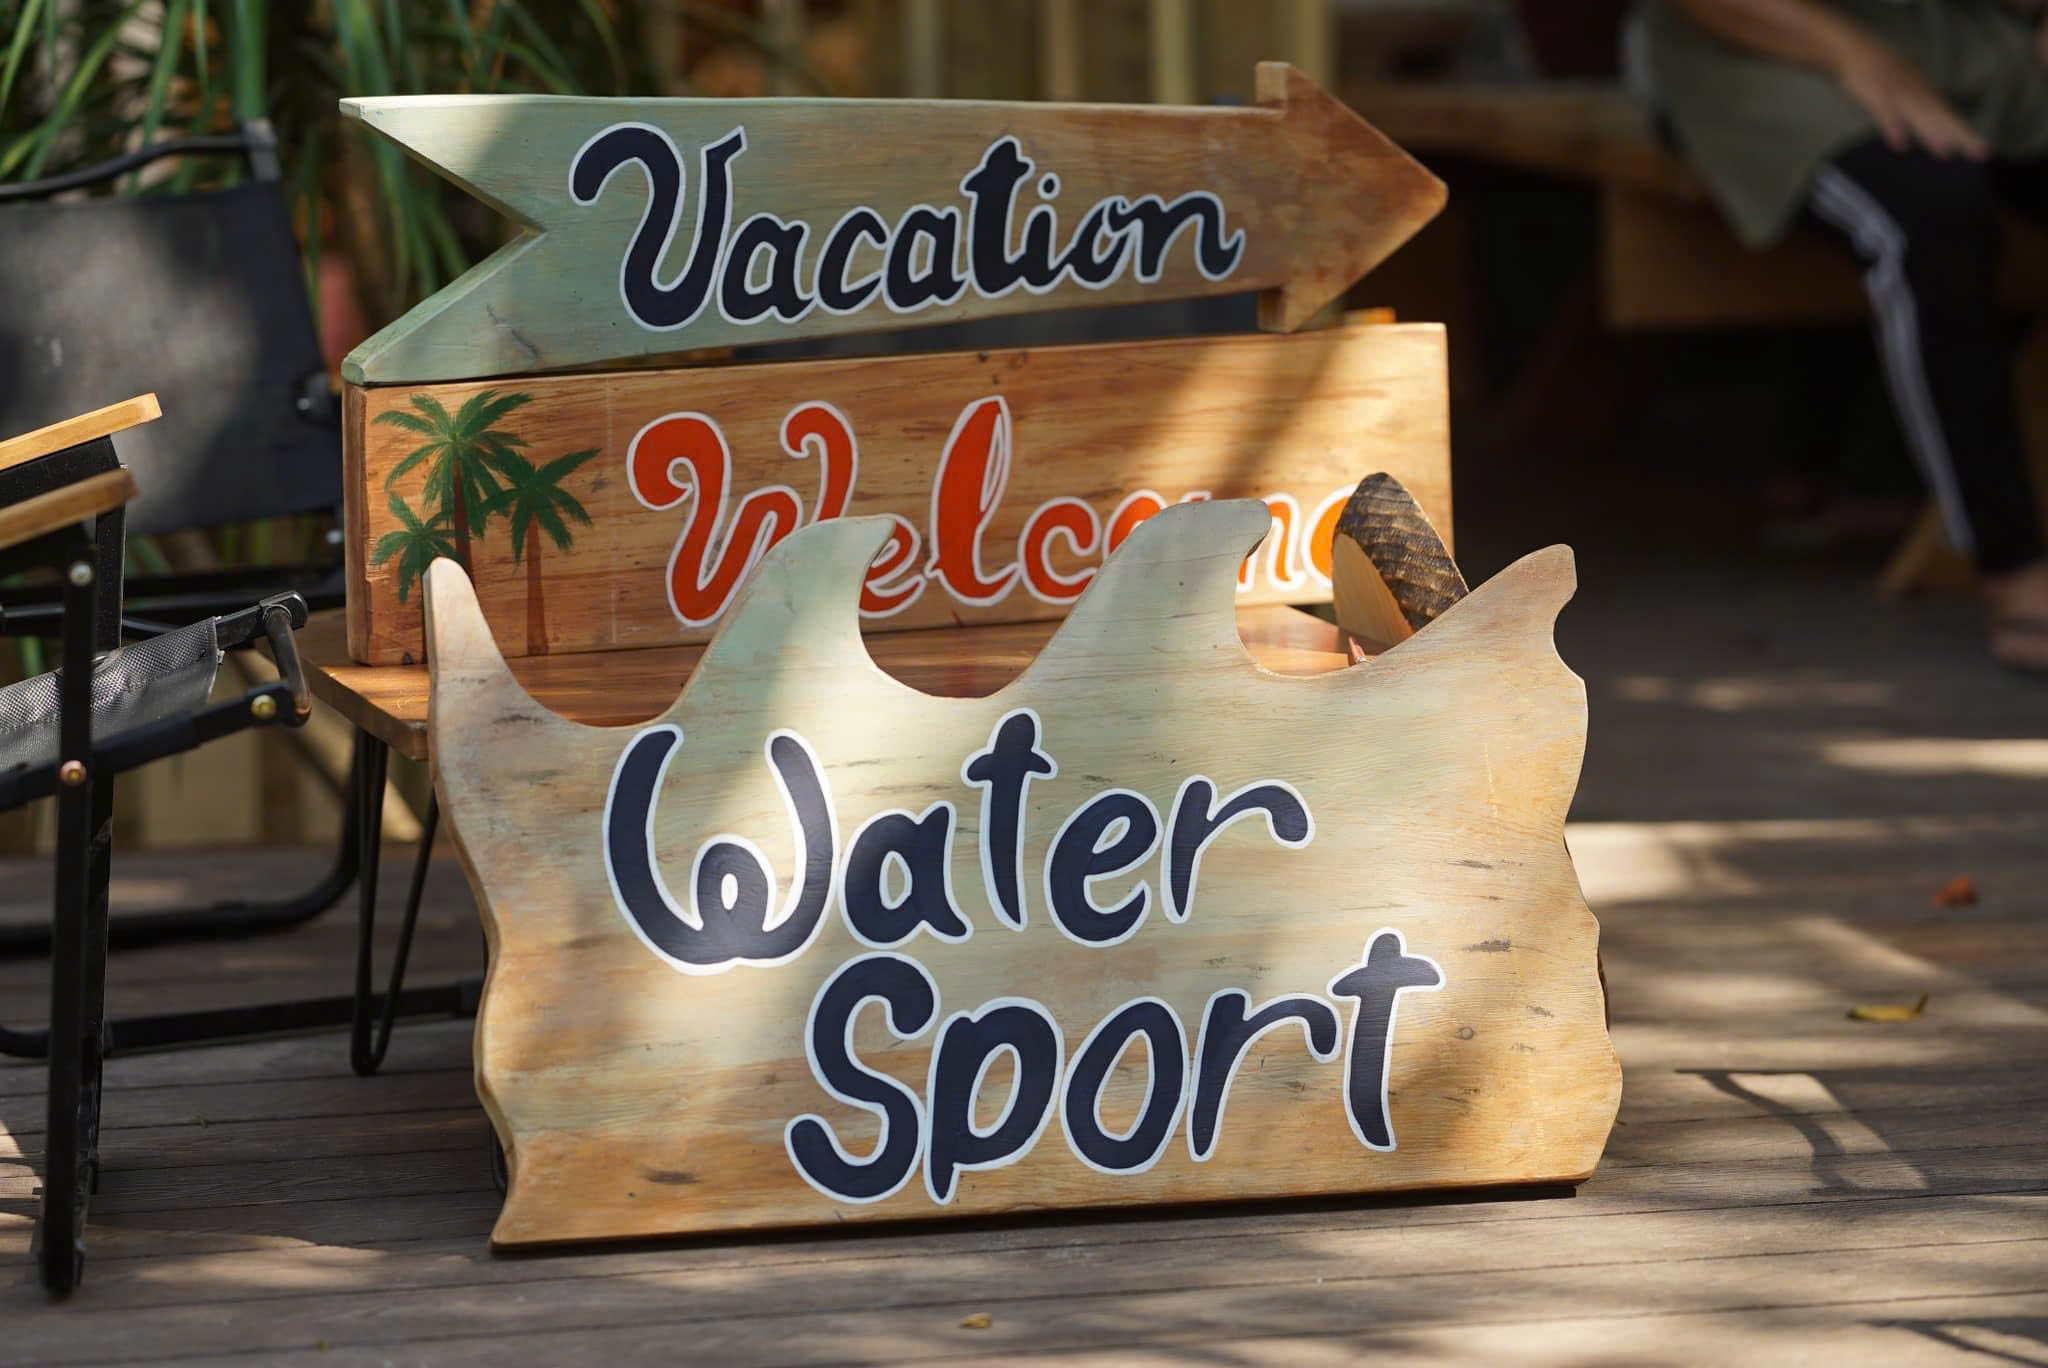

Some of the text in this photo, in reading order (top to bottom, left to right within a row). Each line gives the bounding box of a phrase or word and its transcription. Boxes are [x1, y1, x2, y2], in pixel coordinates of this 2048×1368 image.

[569, 122, 1246, 332] Vacation
[603, 708, 1316, 976] Water
[784, 927, 1447, 1205] Sport
